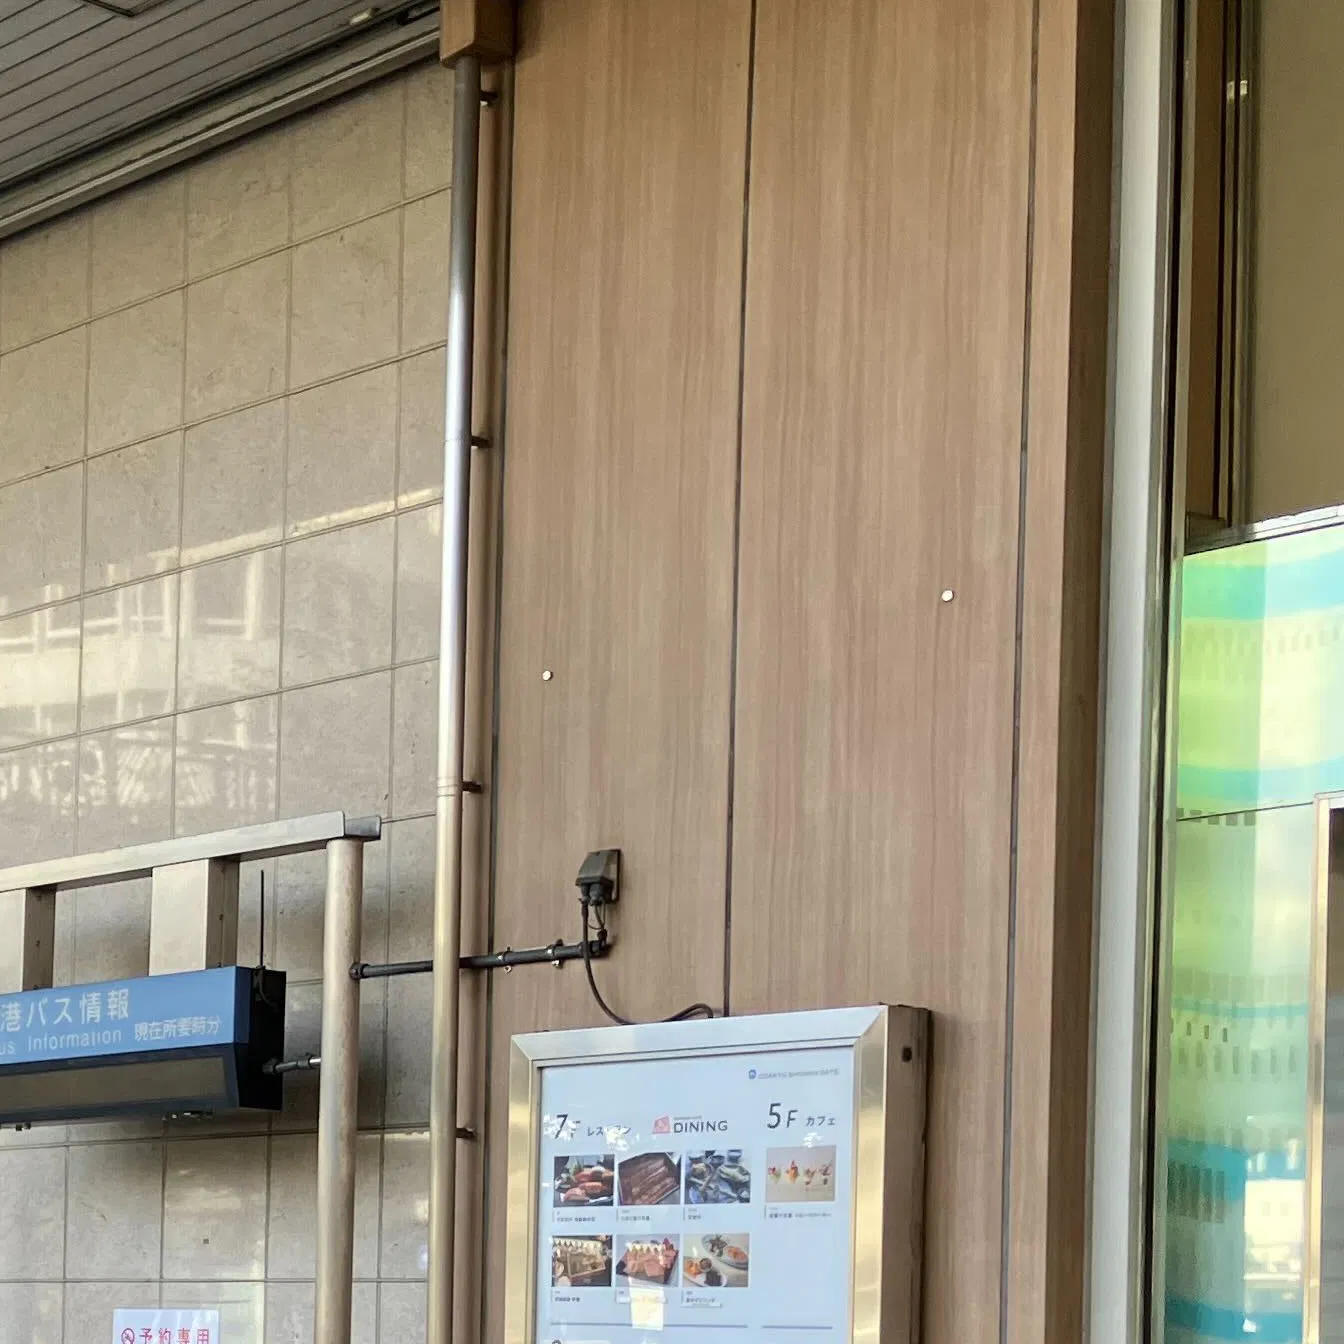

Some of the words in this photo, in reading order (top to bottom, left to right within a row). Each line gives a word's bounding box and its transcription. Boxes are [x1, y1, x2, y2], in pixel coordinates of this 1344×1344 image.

[28, 1029, 122, 1053] Information
[673, 1120, 728, 1133] DINING
[805, 1115, 836, 1127] カフェ
